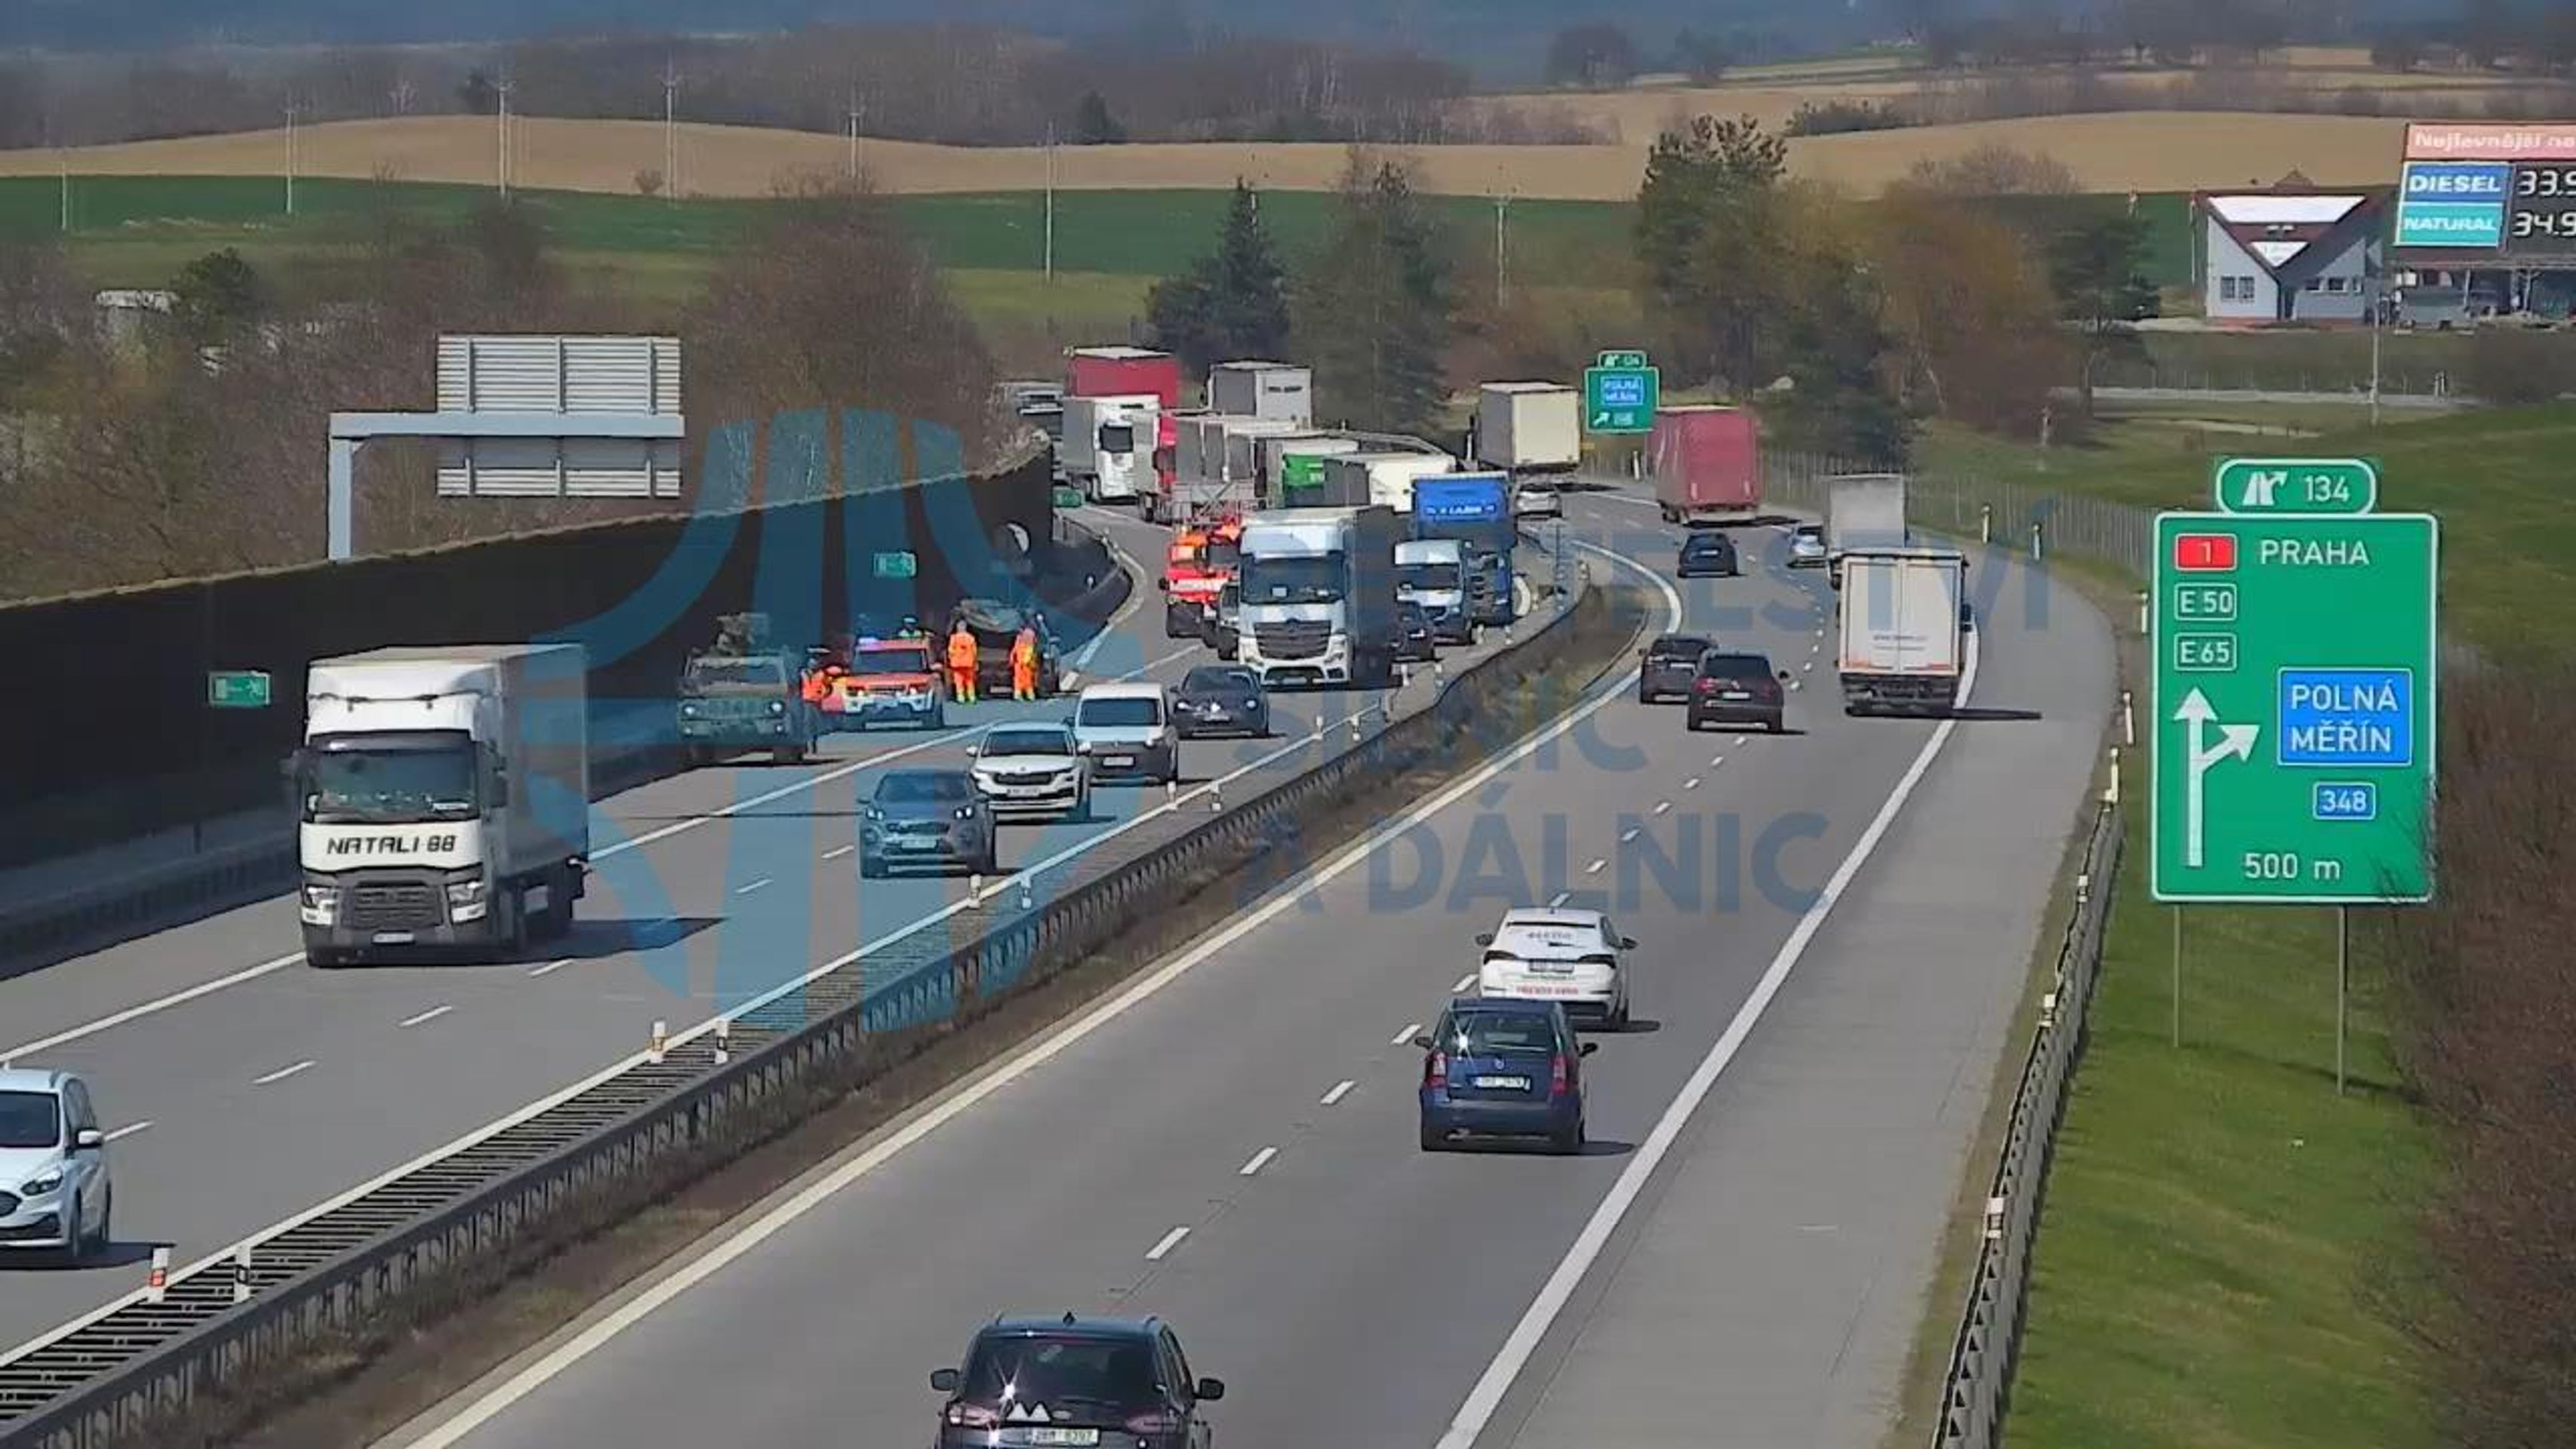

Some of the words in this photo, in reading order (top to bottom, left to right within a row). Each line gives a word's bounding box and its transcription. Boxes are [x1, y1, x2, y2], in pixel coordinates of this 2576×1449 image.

[2408, 175, 2501, 192] DIESEL
[2403, 217, 2498, 231] NATURAL
[2304, 475, 2350, 501] 134
[2199, 541, 2212, 563] 1
[2261, 539, 2369, 565] PRAHA
[2290, 678, 2399, 711] POLNÁ
[2290, 719, 2391, 752] MĚŘÍN
[2322, 789, 2367, 812] 348
[327, 836, 420, 854] NATALI
[426, 835, 457, 852] 88
[2244, 853, 2298, 878] 500
[2314, 860, 2341, 879] m
